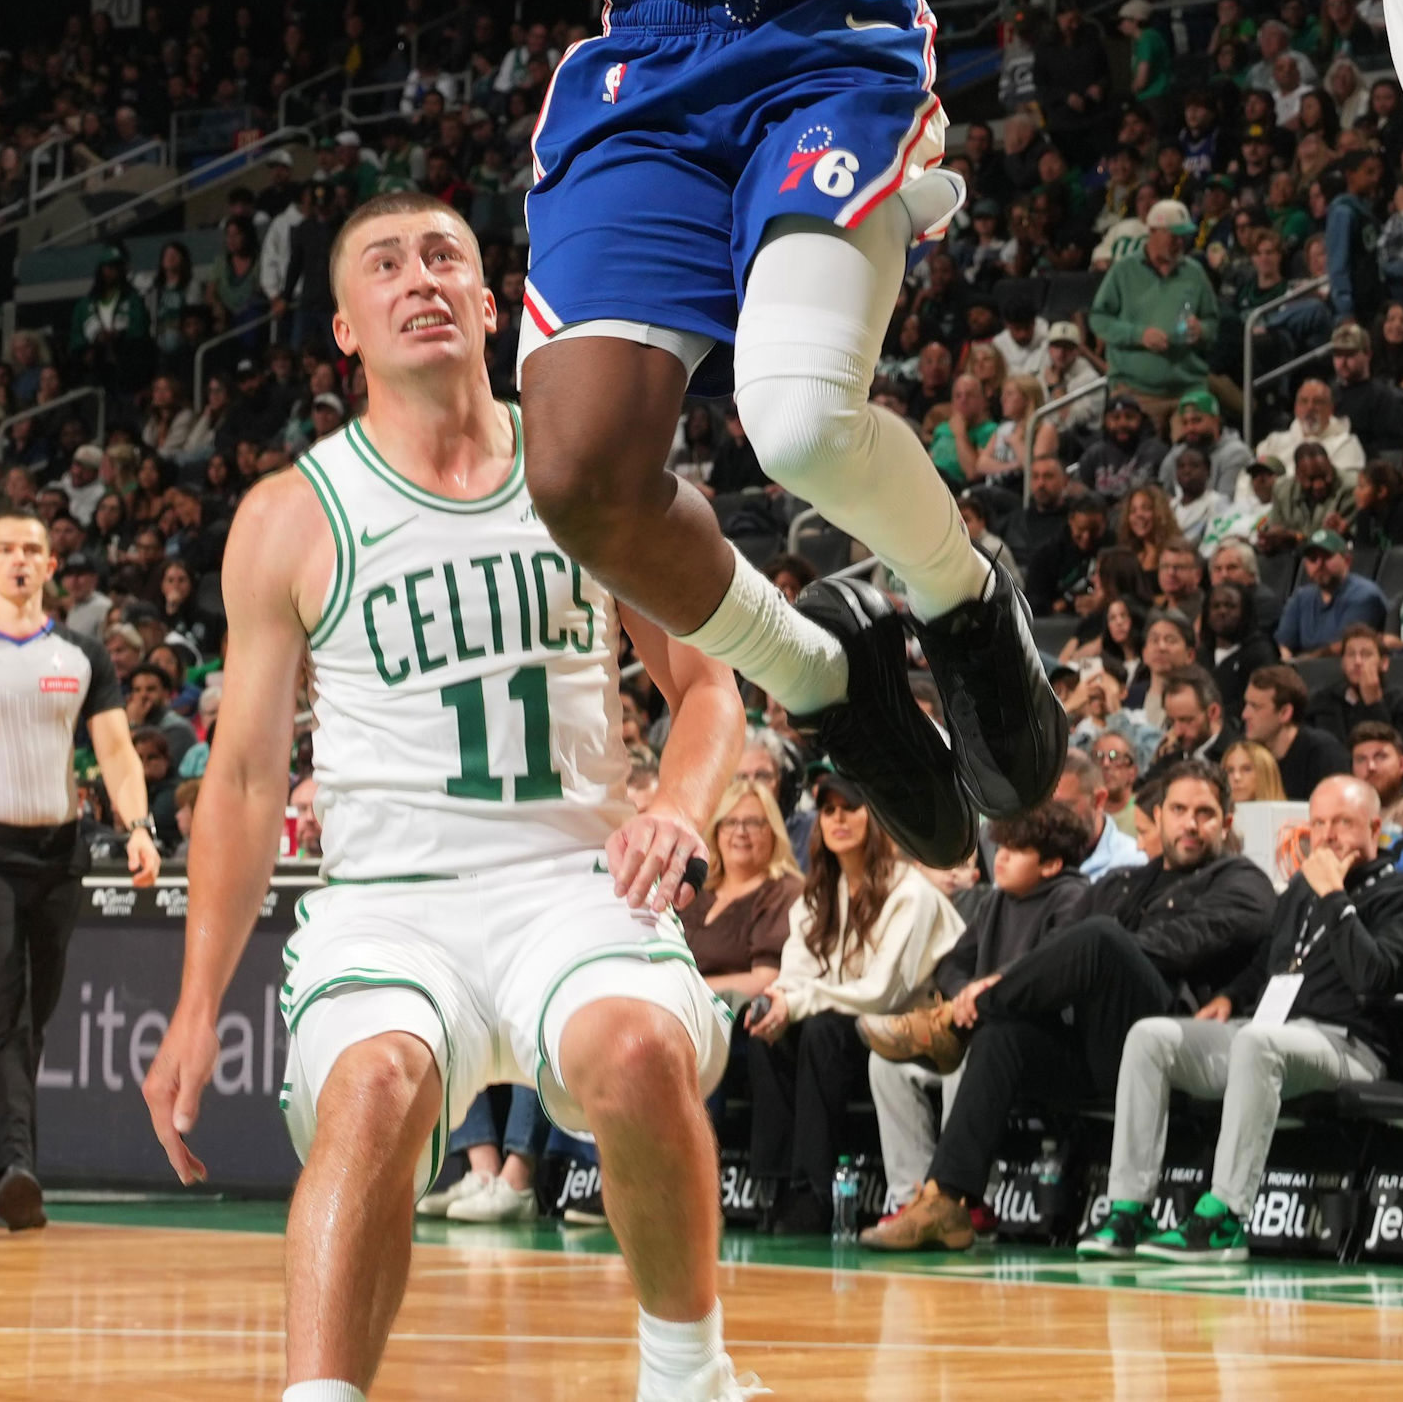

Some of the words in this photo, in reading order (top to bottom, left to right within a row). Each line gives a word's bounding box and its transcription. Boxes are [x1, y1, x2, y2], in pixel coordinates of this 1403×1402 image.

[779, 149, 859, 197] 76
[362, 550, 595, 689] CELTICS
[440, 666, 564, 801] 11
